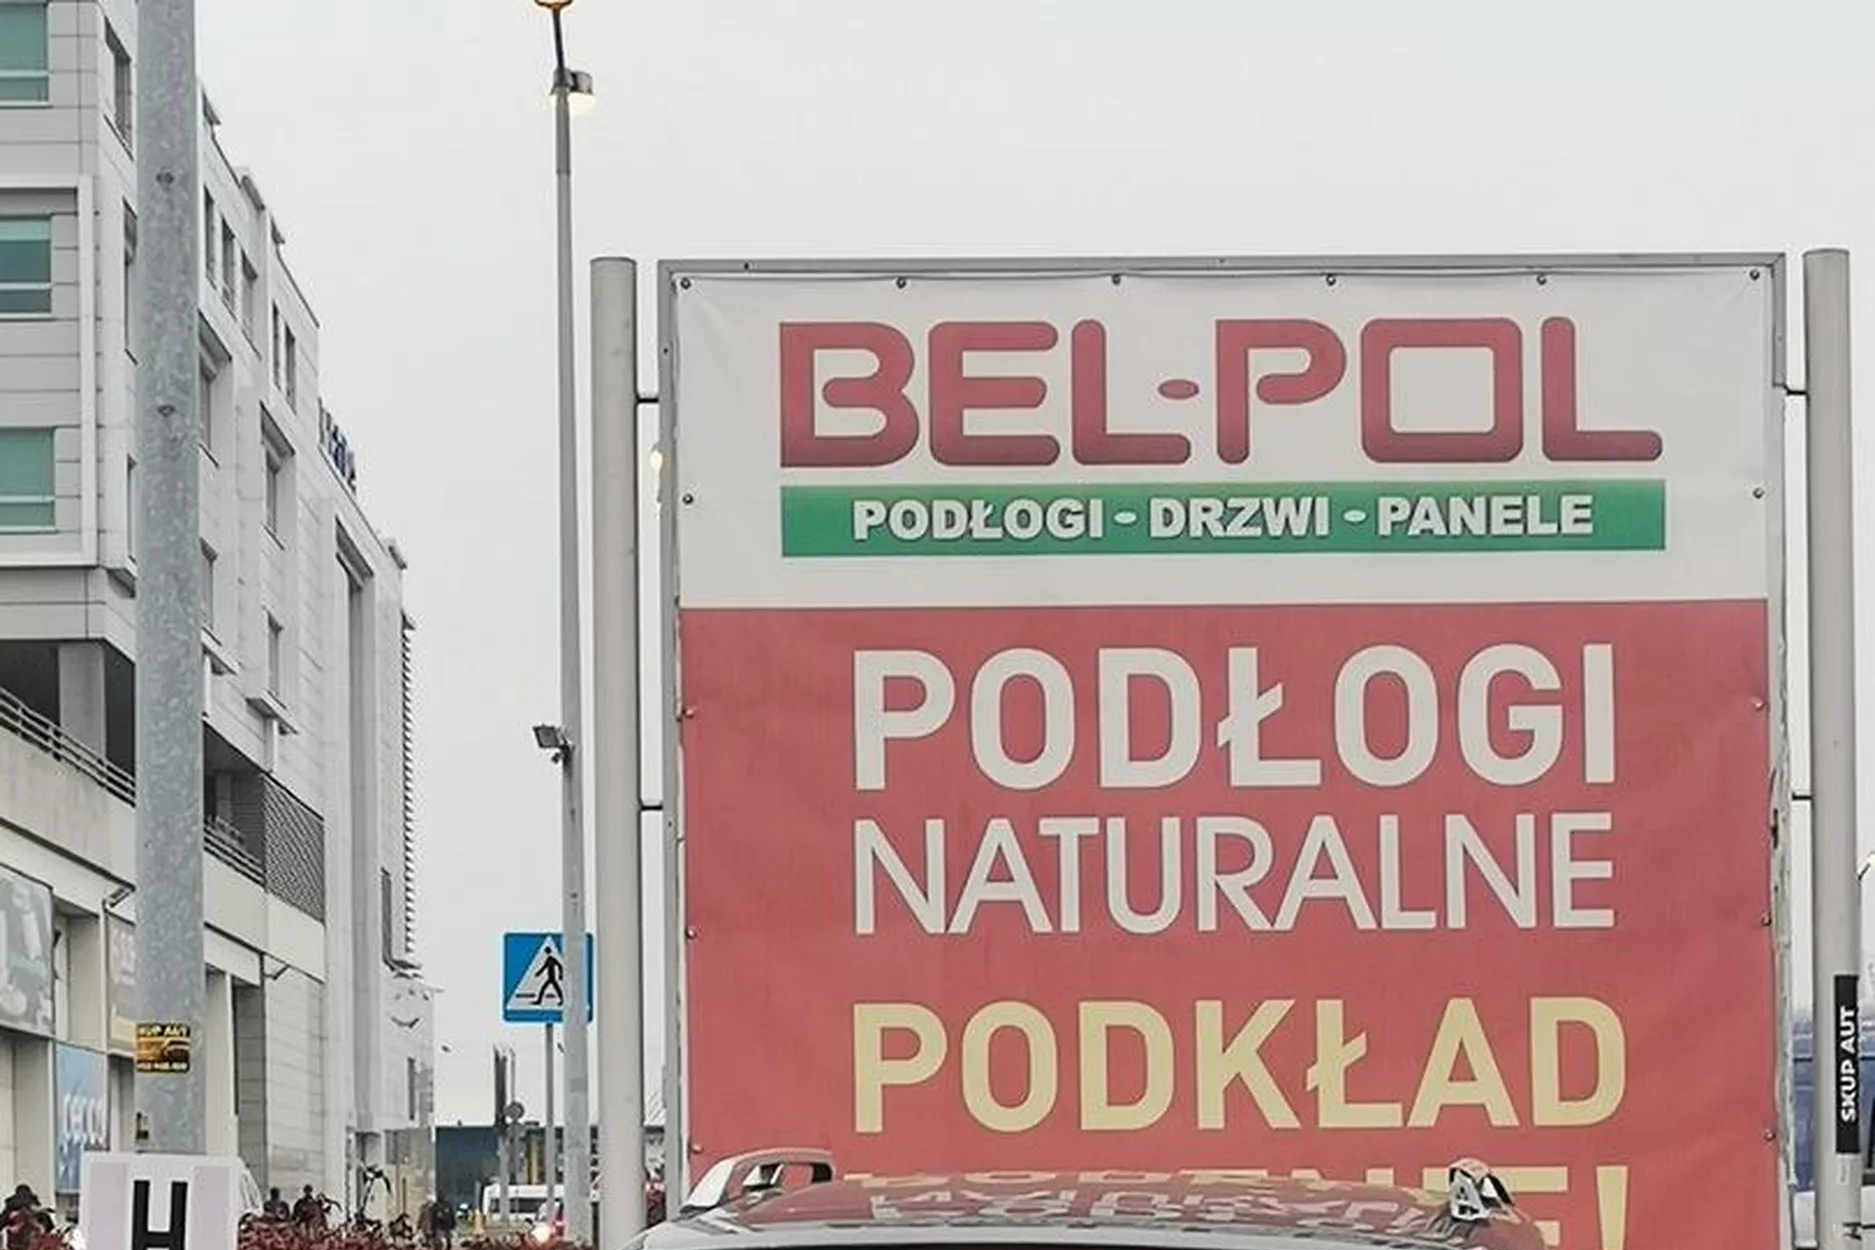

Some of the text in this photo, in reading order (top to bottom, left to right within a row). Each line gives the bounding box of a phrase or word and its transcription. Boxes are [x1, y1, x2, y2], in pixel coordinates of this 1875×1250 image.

[780, 317, 1664, 468] BEL-POL
[852, 497, 1104, 541] PODŁOGI
[1149, 494, 1330, 537] DRZWI
[1377, 492, 1594, 536] PANELE
[853, 643, 1617, 791] PODŁOGI
[854, 811, 1616, 936] NATURALNE
[853, 997, 1628, 1134] PODKŁAD
[1840, 1005, 1857, 1124] SKUP AUT
